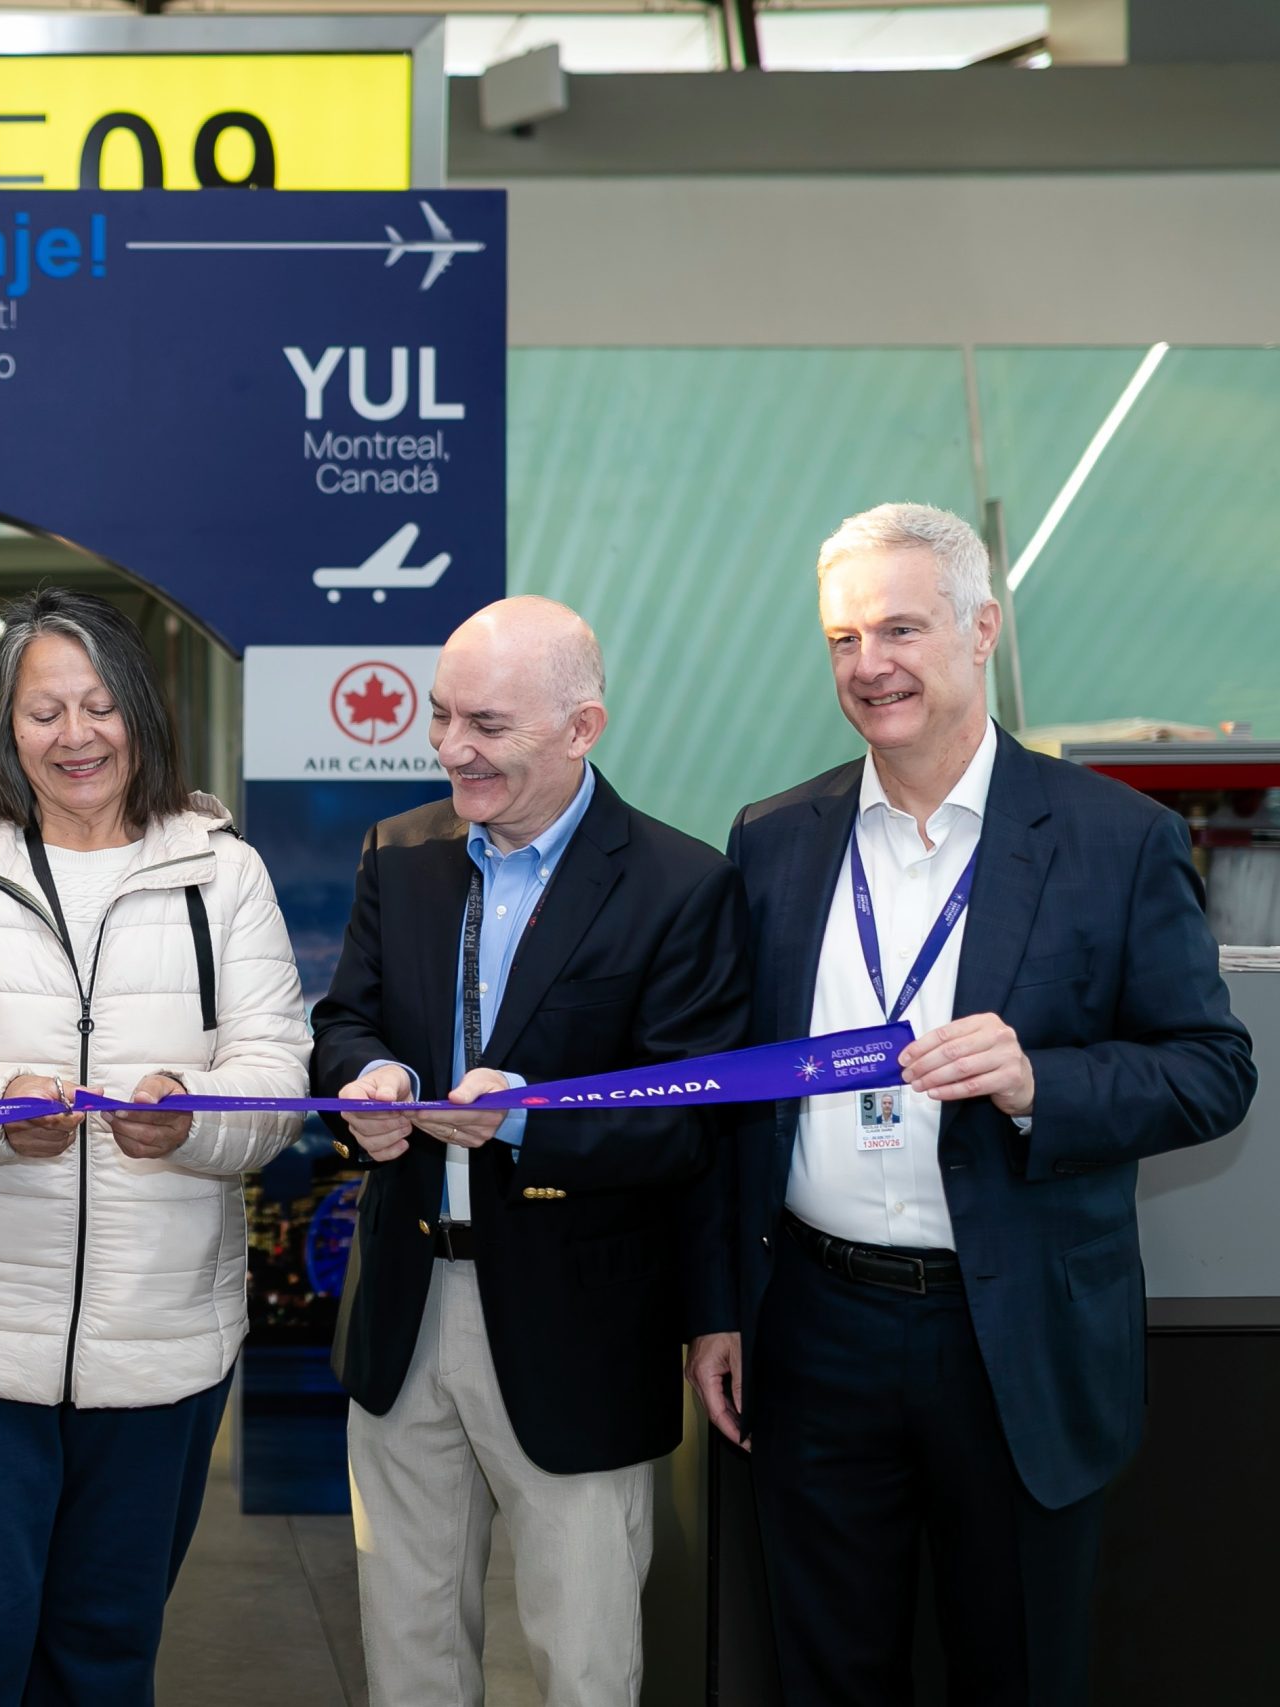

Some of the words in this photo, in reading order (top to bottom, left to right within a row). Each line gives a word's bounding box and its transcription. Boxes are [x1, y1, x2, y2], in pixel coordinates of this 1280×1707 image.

[282, 346, 466, 421] YUL
[303, 430, 451, 462] Montreal,
[315, 463, 440, 495] Canadá
[303, 756, 342, 772] AIR
[348, 756, 443, 773] CANADA
[831, 1041, 894, 1059] AEROPUERTO
[832, 1052, 887, 1069] SANTIAGO
[835, 1068, 849, 1078] DE
[849, 1063, 878, 1076] CHILE
[559, 1093, 604, 1102] AIR
[609, 1079, 721, 1100] CANADA
[863, 1094, 874, 1111] 5
